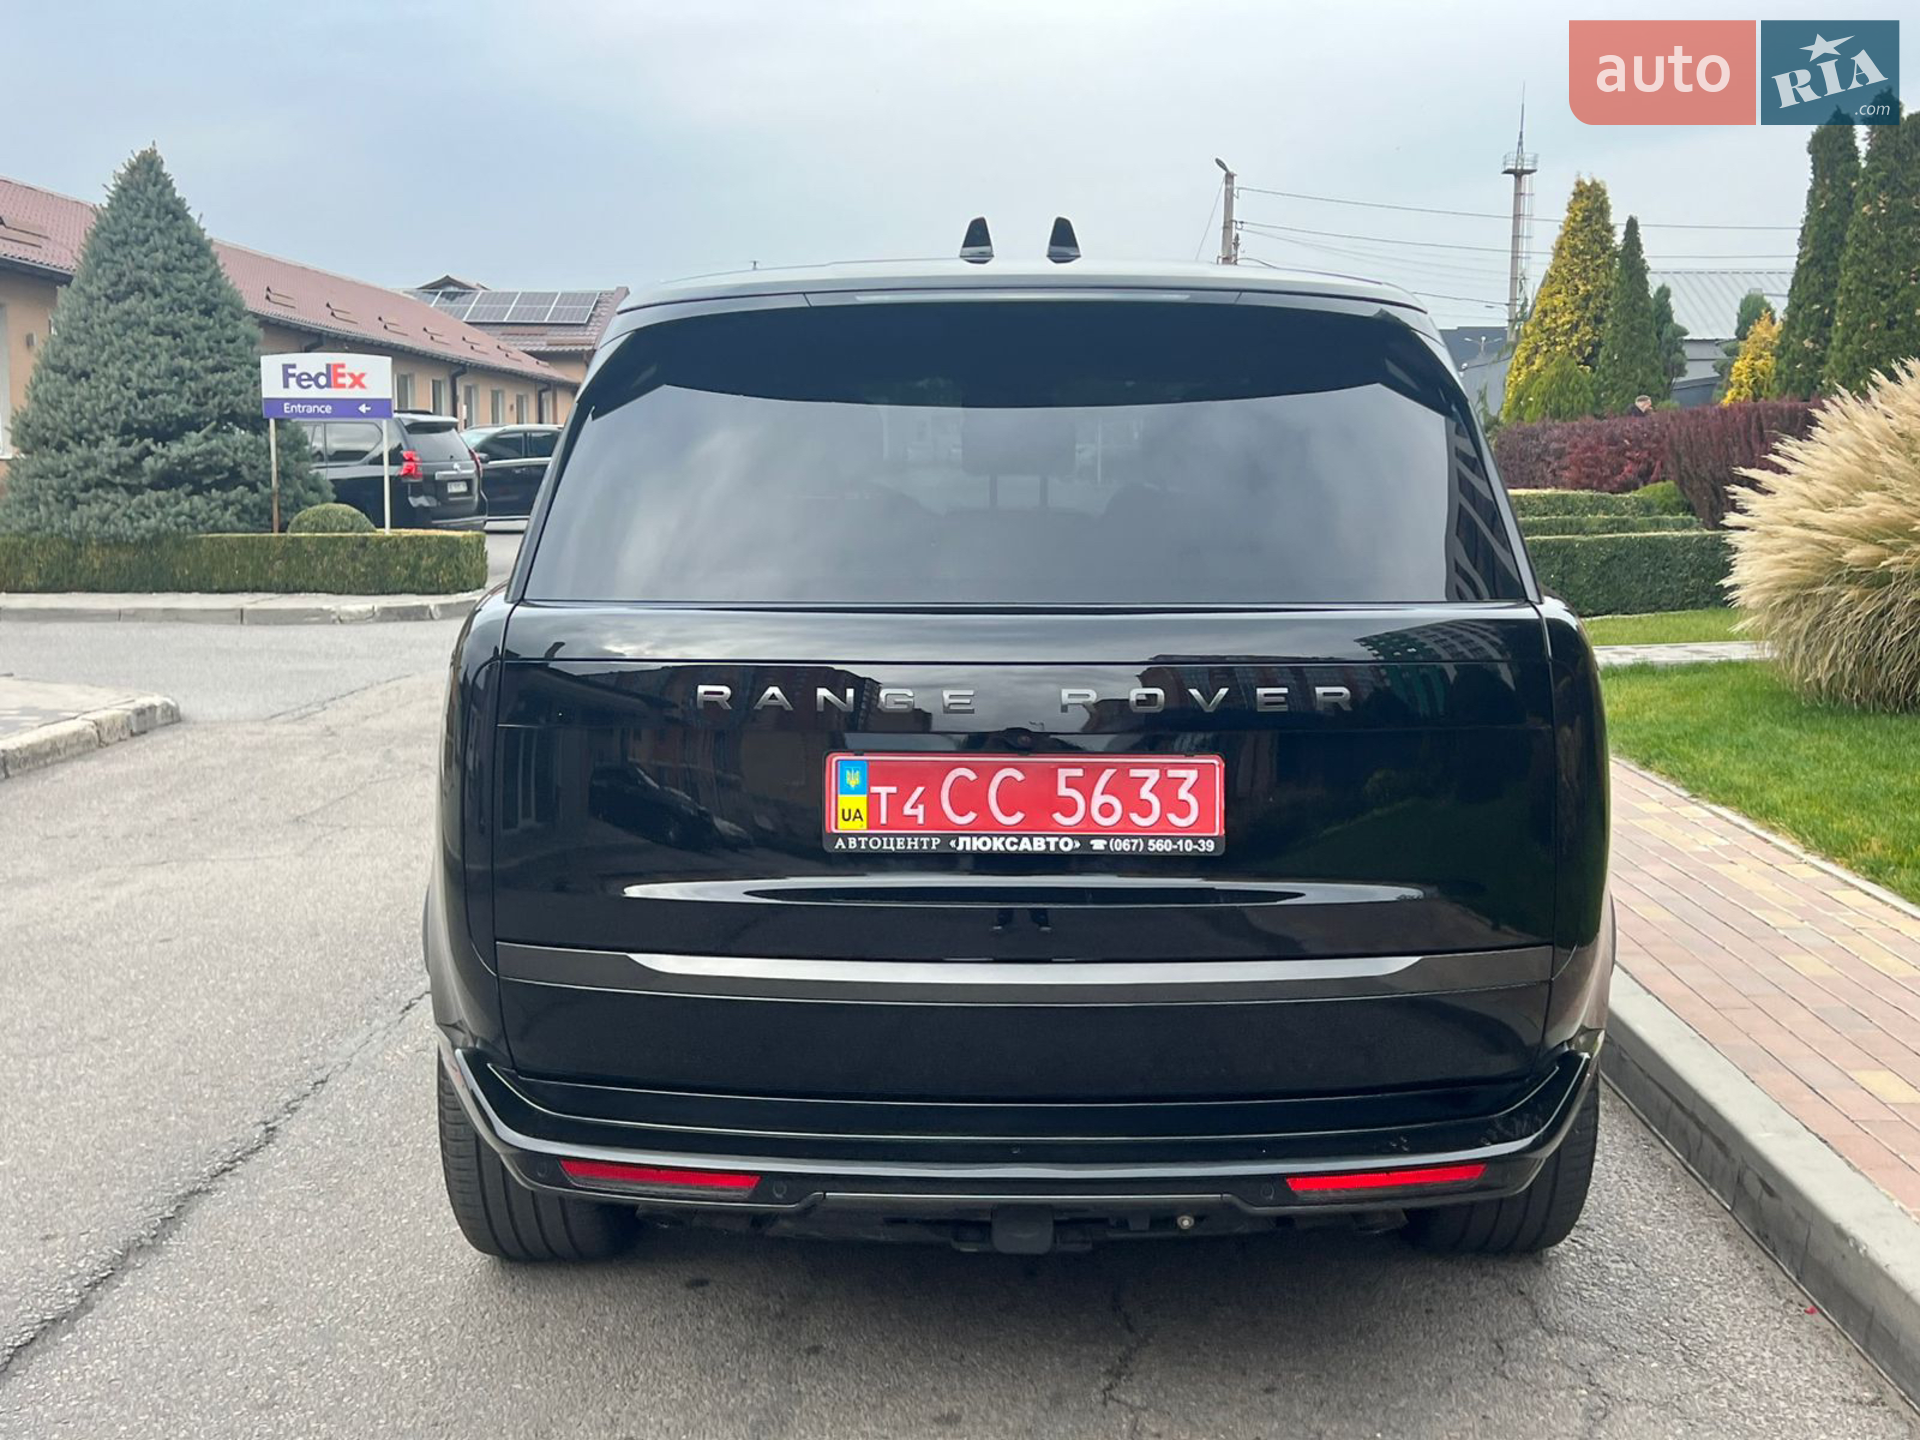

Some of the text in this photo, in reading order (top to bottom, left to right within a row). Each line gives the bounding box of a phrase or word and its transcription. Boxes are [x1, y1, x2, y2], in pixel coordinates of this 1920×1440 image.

[281, 363, 366, 389] FedEx
[283, 402, 332, 414] Entrance
[696, 684, 1354, 714] RANGE ROVER
[1051, 767, 1199, 828] 5633
[841, 806, 864, 823] UA
[834, 836, 1216, 853] АВТОЦЕНТР «ЛЮКСАВТО» (067) 560-10-39
